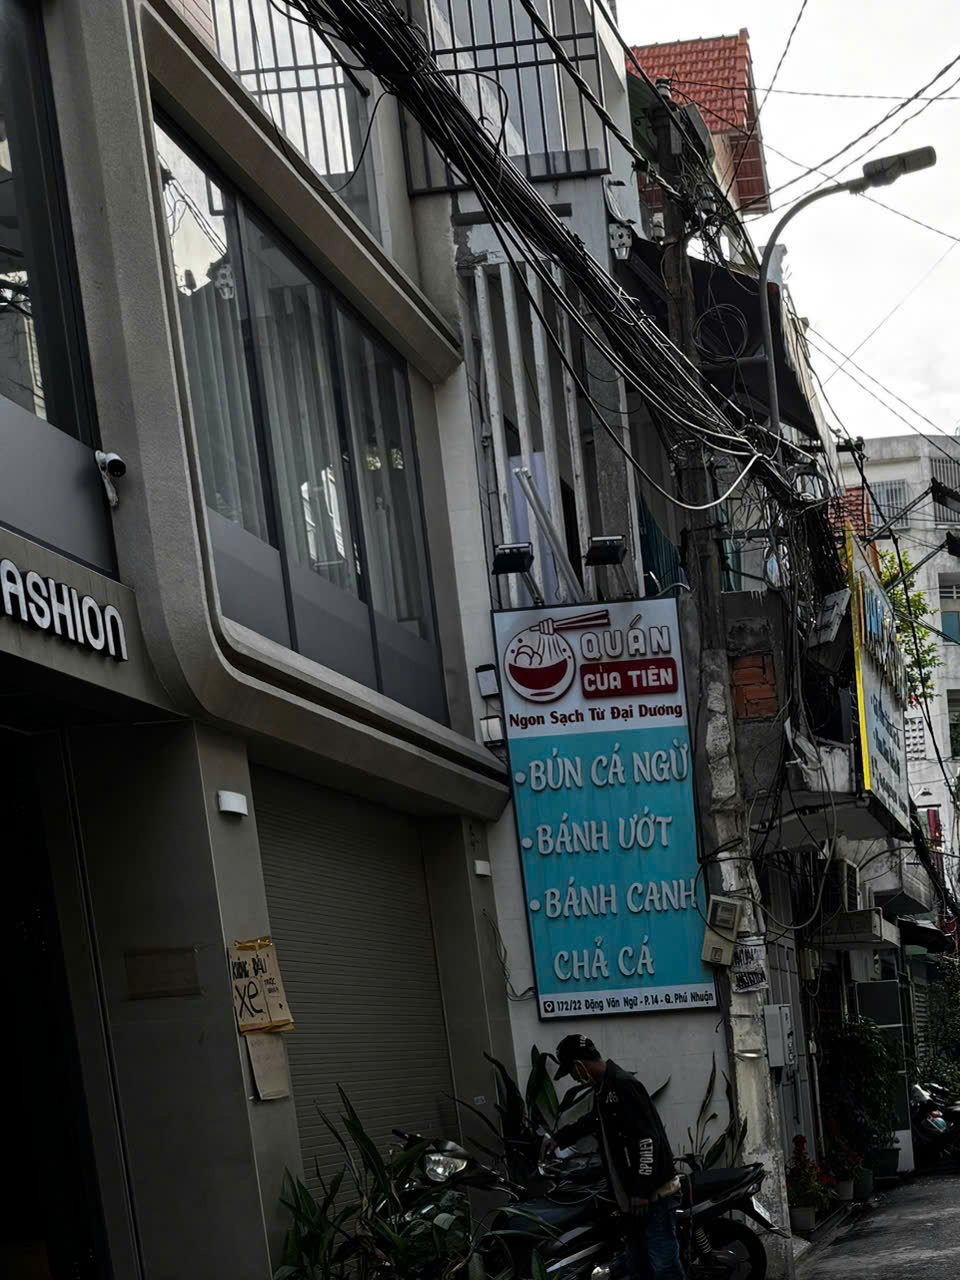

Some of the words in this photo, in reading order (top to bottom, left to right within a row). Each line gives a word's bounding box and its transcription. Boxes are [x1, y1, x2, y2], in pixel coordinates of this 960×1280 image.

[580, 614, 672, 661] QUÁN
[583, 664, 622, 691] CỦA
[627, 666, 674, 688] TIÊN
[509, 713, 545, 729] Ngon
[550, 709, 584, 727] Sạch
[588, 707, 606, 721] Từ
[610, 704, 634, 721] Đại
[639, 704, 683, 718] Dương
[529, 748, 583, 791] BÚN
[591, 742, 625, 787] CÁ
[632, 738, 688, 783] NGỪ
[536, 812, 609, 855] BÁNH
[618, 806, 672, 849] ƯỚT
[544, 876, 617, 918] BÁNH
[626, 879, 697, 913] CANH
[553, 936, 610, 980] CHẢ
[618, 935, 655, 976] CÁ
[557, 1000, 582, 1012] 172/22
[584, 998, 604, 1012] Đặng
[606, 997, 621, 1008] Văn
[675, 992, 688, 1003] Phú
[690, 990, 714, 1004] Nhuận
